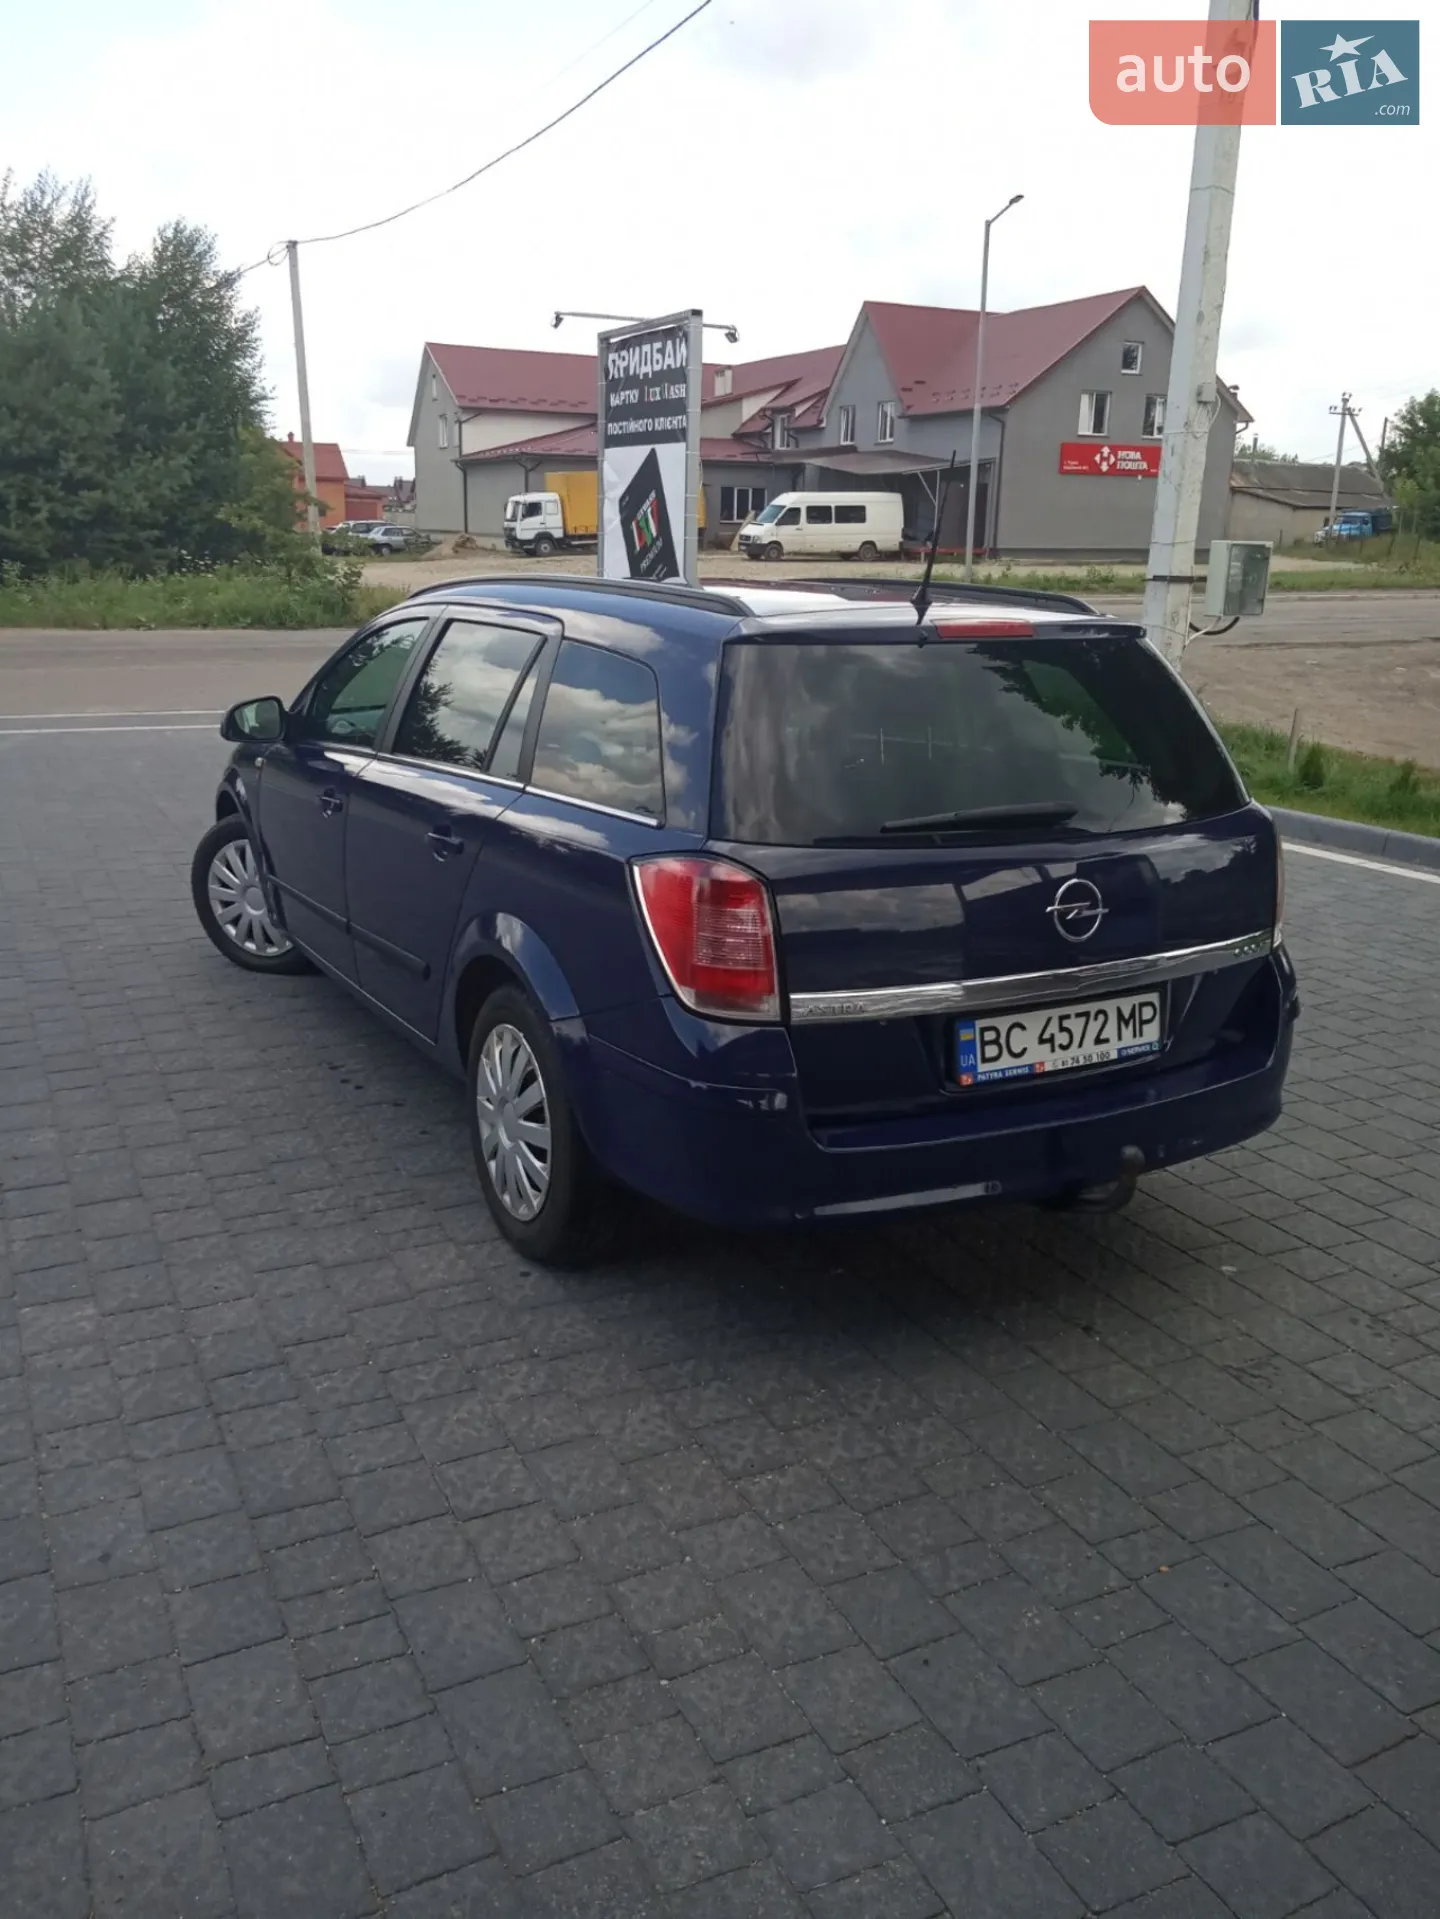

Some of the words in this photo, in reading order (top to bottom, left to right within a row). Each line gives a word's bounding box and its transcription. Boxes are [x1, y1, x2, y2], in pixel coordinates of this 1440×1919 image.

[610, 389, 639, 407] КАРТКУ
[607, 418, 653, 435] ПОСТІЙНОГО
[654, 415, 687, 431] КЛІЄНТА
[1117, 450, 1141, 460] НОВА
[1116, 460, 1148, 470] ПОШТА
[806, 1001, 866, 1017] ASTRA
[979, 1021, 1028, 1064] BC
[1038, 1009, 1110, 1053] 4572
[1116, 1001, 1158, 1042] MP
[960, 1054, 976, 1068] UA
